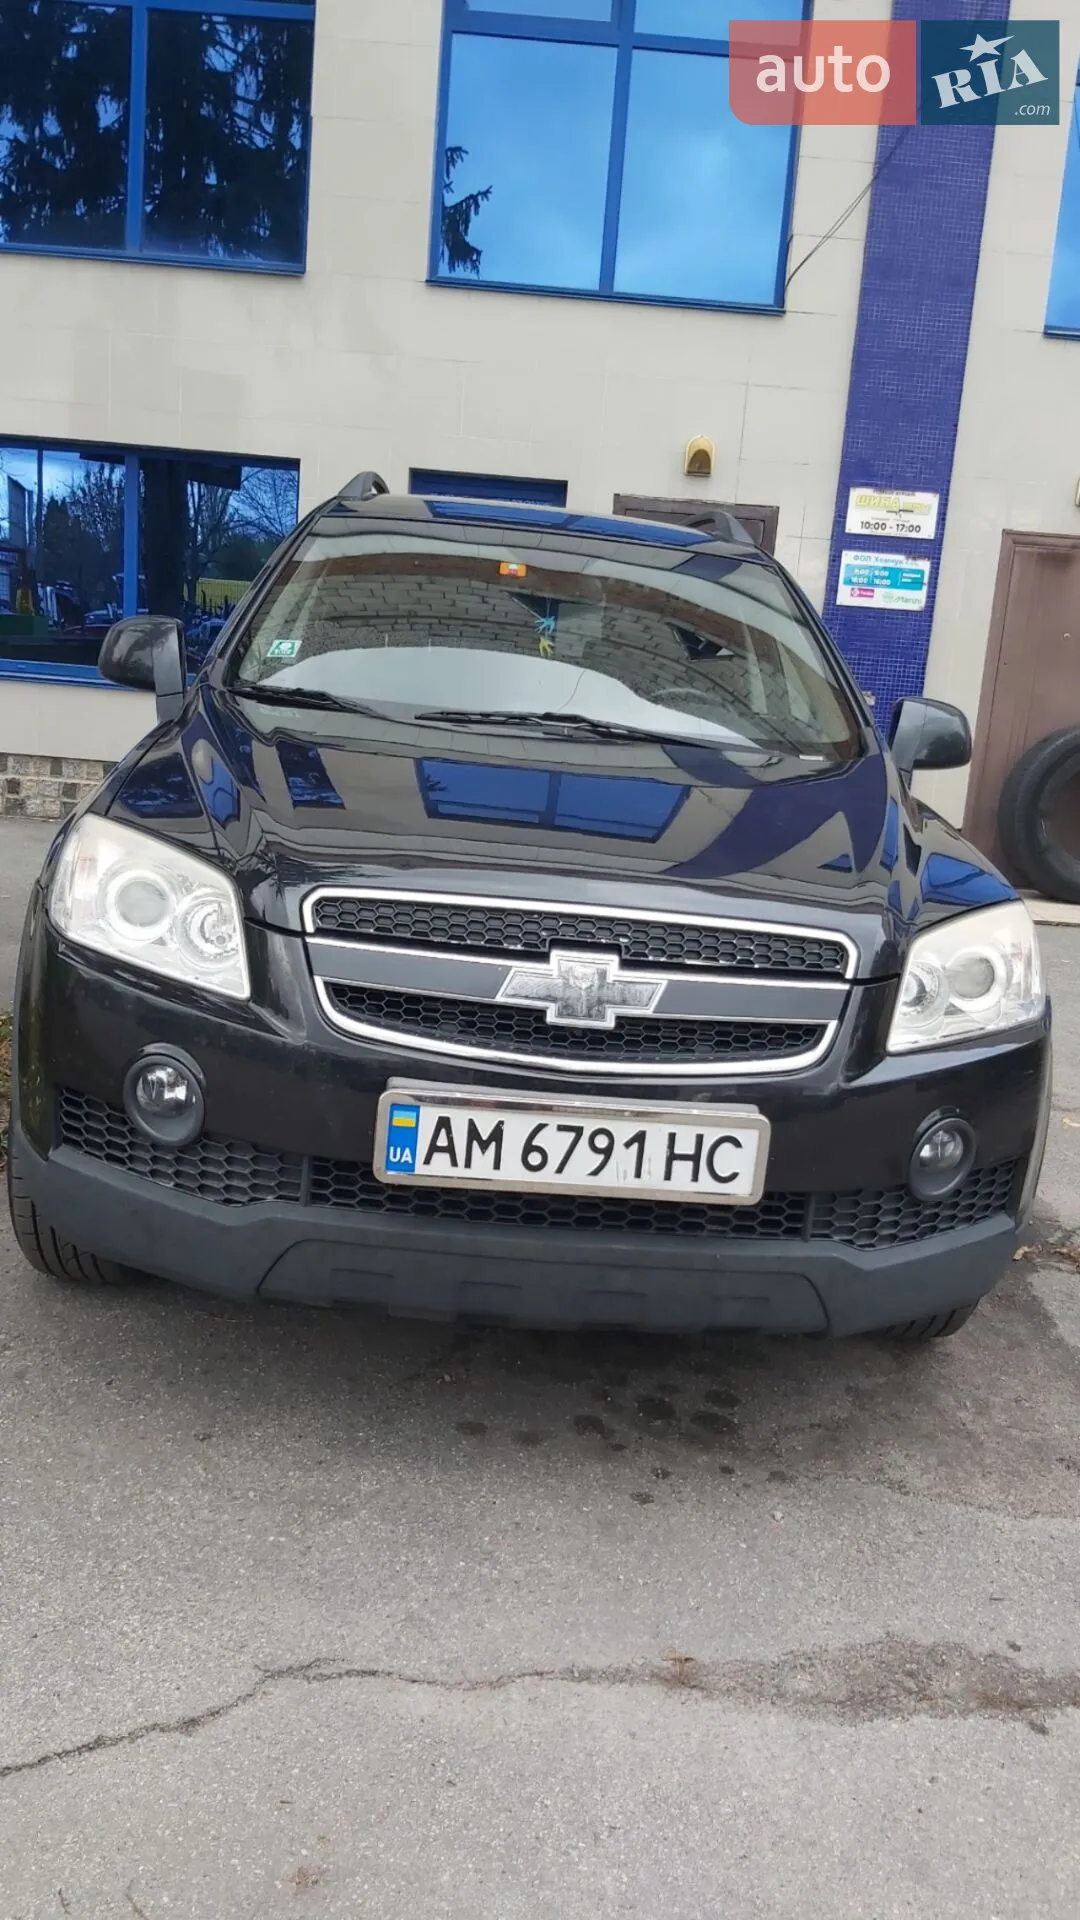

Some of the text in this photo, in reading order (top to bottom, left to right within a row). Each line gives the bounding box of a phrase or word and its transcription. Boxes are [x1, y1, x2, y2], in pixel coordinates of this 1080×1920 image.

[857, 495, 900, 509] ШИНА
[861, 521, 887, 531] 10:00
[896, 524, 921, 533] 17:00
[389, 1145, 413, 1165] UA
[422, 1115, 743, 1184] AM 6791 HC
